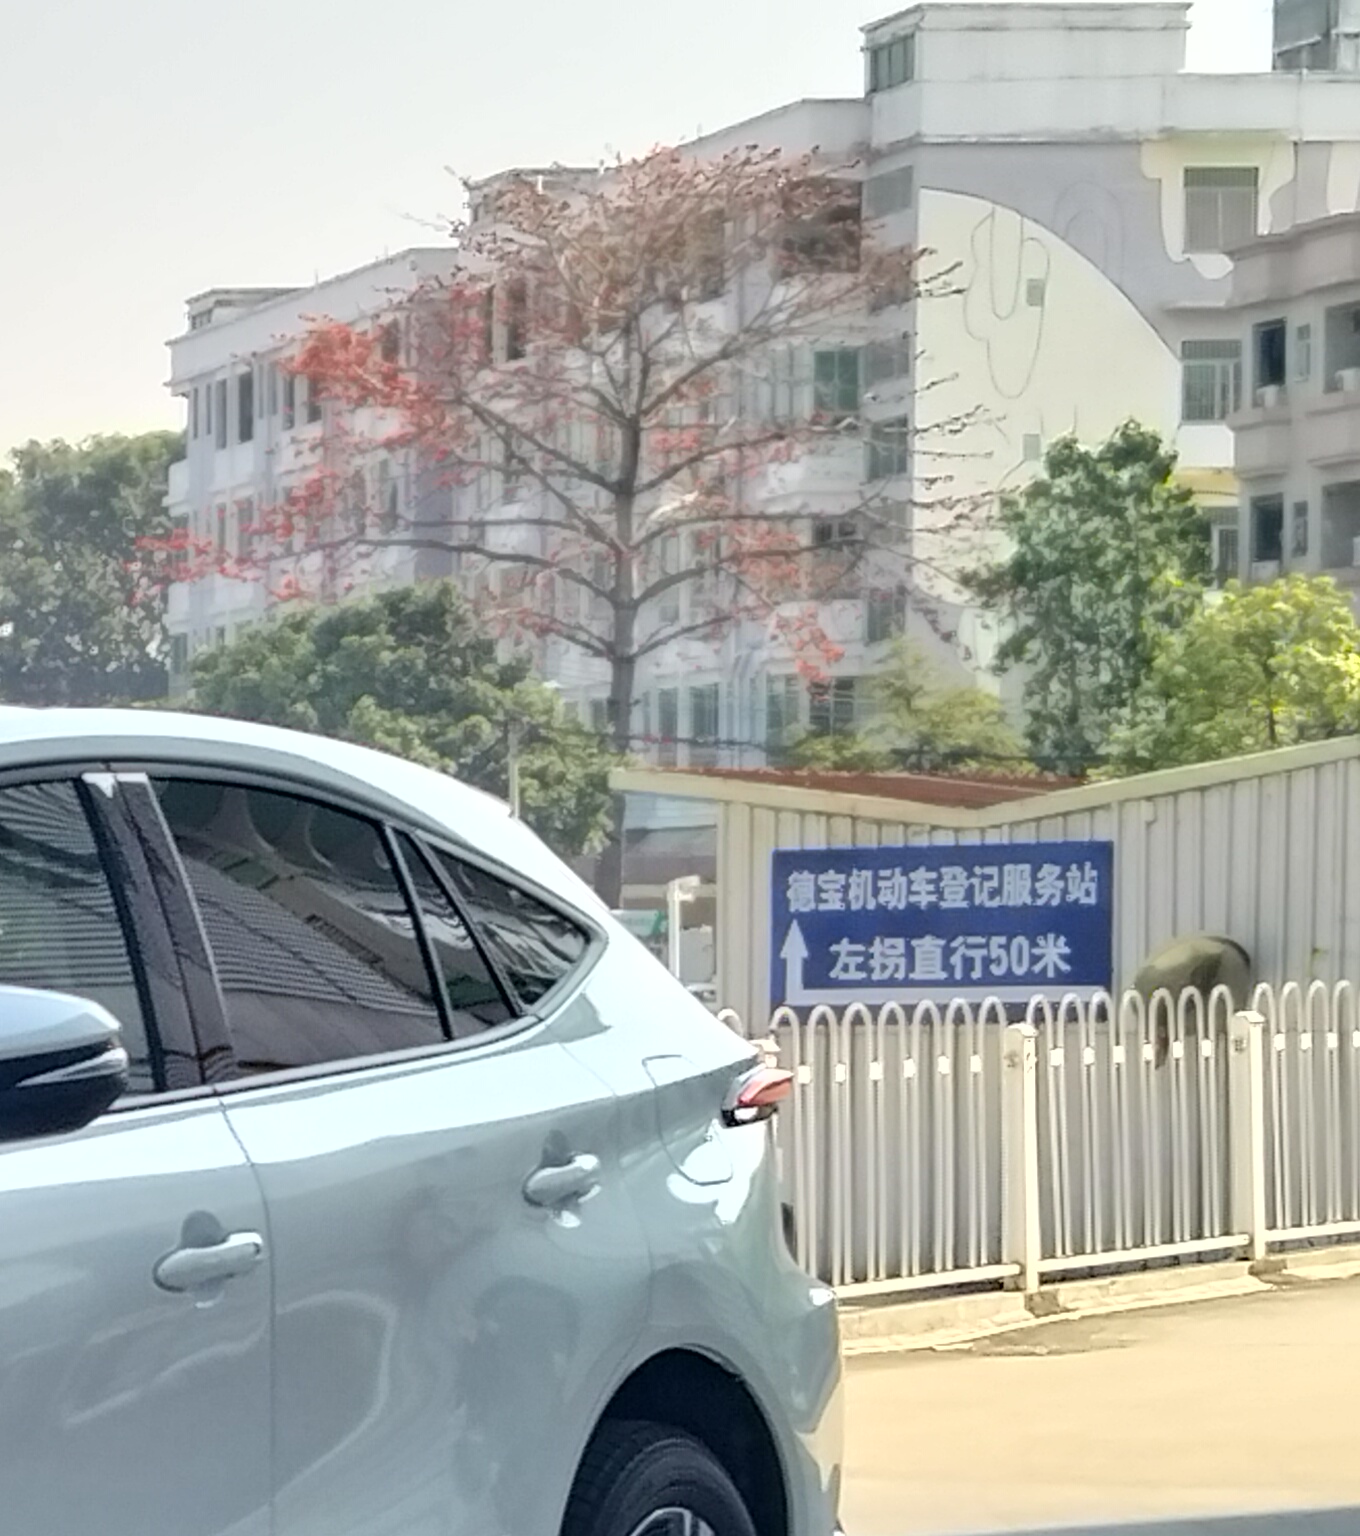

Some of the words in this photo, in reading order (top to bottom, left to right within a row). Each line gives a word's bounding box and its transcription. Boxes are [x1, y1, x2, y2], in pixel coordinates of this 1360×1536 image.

[786, 860, 1098, 911] 德宝机动车登记服务站
[829, 932, 1071, 982] 左拐直行50米
